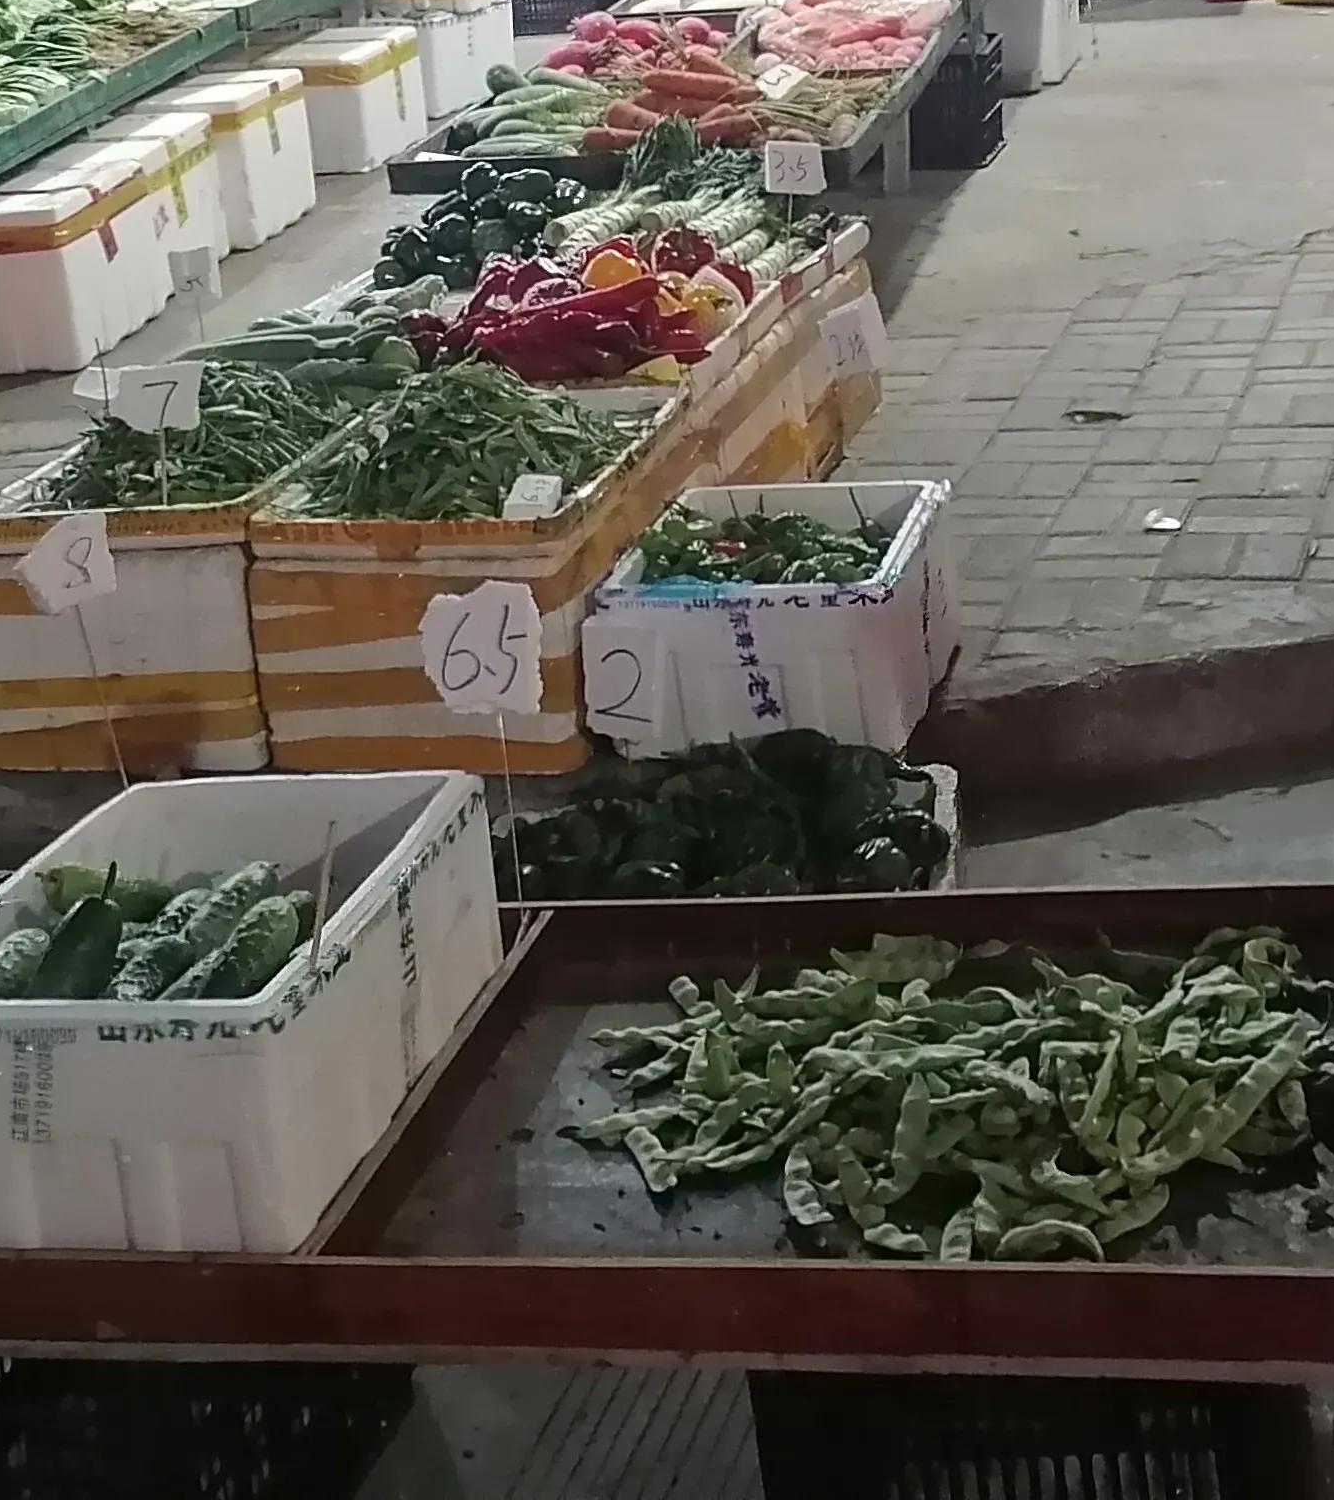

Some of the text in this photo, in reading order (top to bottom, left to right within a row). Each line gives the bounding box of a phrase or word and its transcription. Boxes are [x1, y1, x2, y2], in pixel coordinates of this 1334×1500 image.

[141, 380, 179, 429] 7
[64, 536, 93, 589] 8
[594, 648, 653, 724] 2
